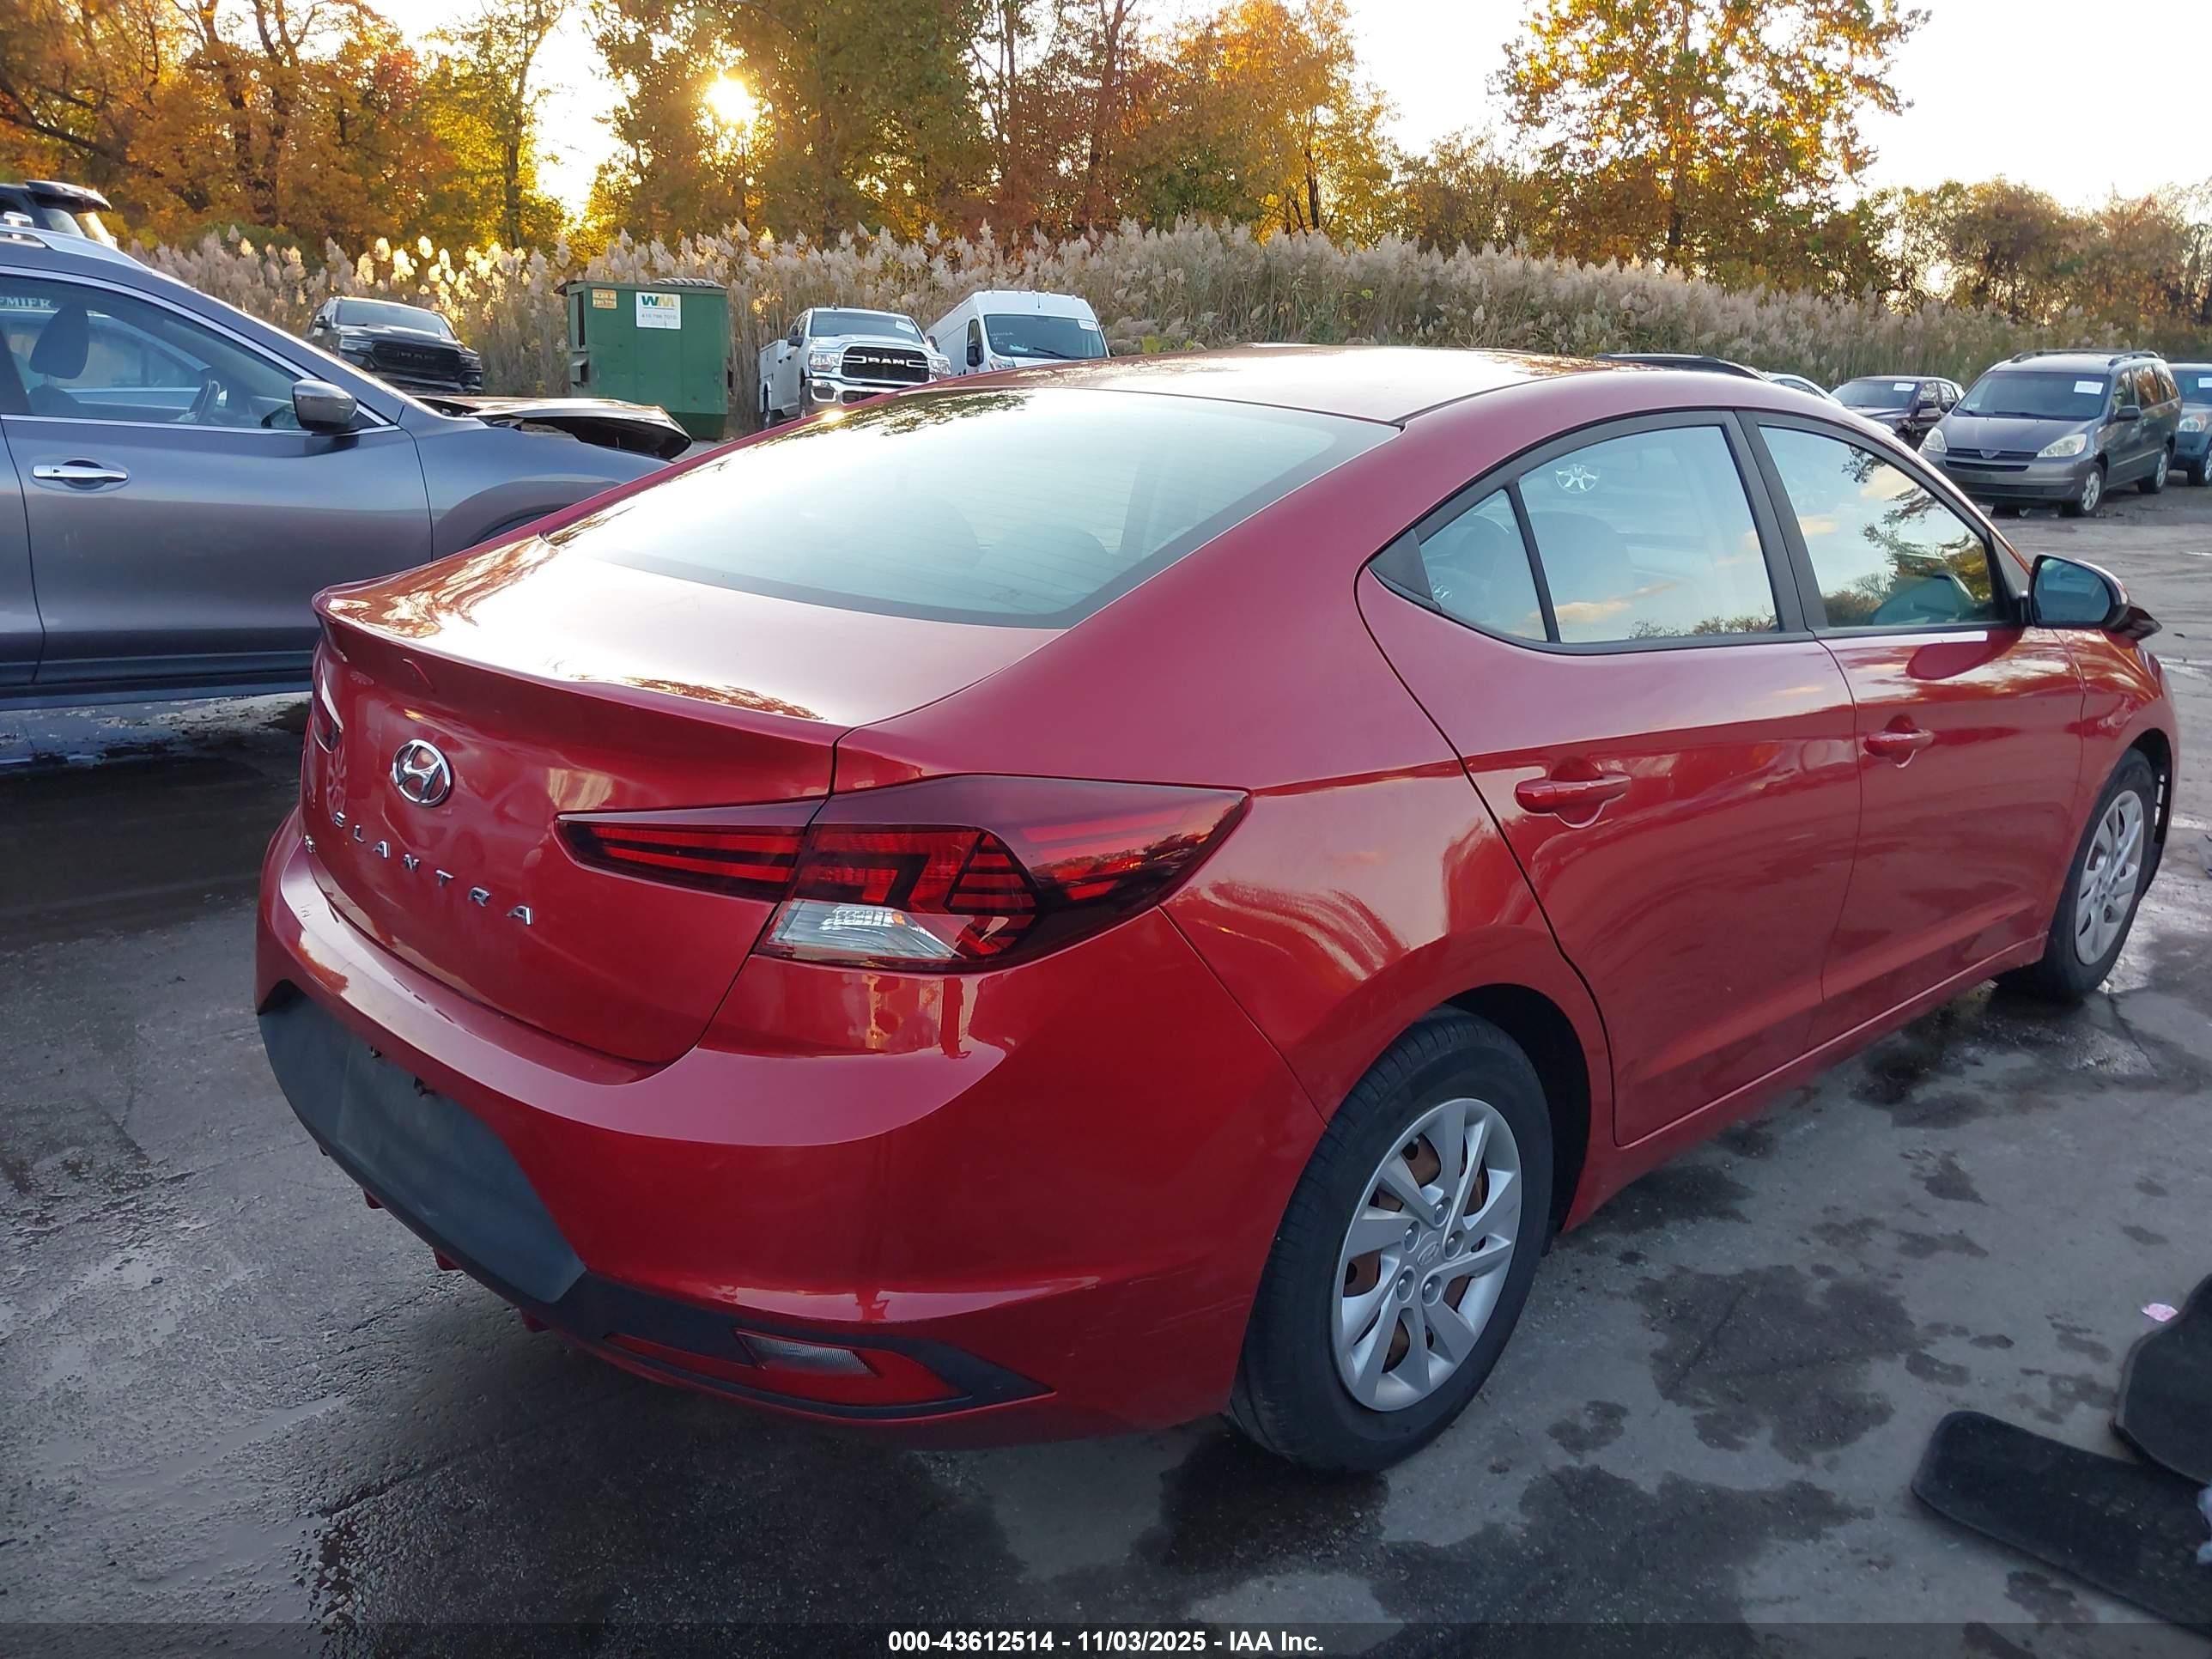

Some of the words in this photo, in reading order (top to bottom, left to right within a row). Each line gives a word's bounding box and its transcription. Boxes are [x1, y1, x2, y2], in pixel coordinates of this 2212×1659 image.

[641, 295, 674, 307] WM
[867, 356, 905, 366] RAM
[334, 811, 533, 926] ELANTRA
